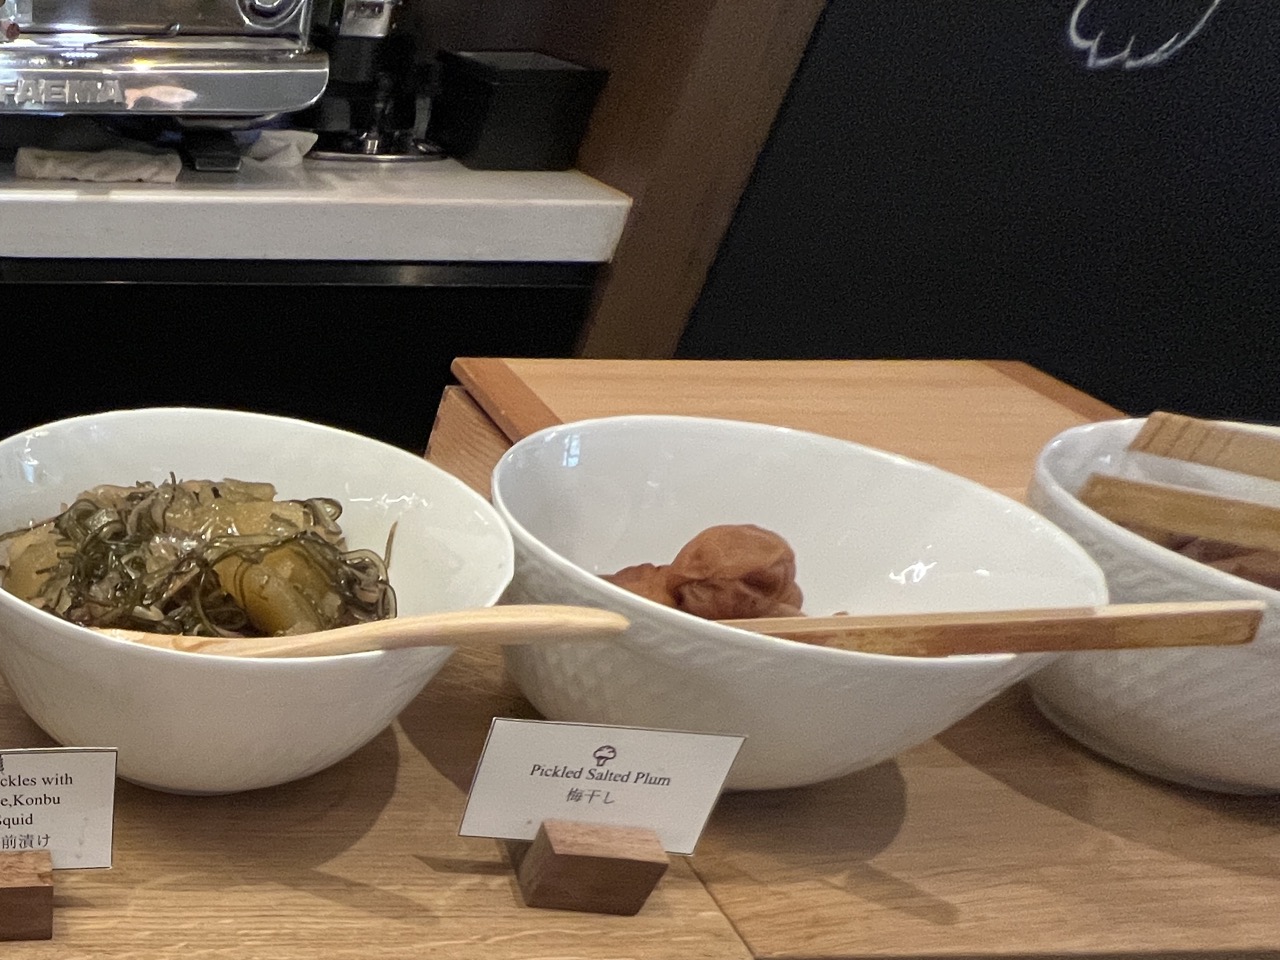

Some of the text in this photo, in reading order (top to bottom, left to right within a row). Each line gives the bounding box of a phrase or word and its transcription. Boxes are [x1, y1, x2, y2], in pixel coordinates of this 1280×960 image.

[42, 773, 73, 786] with
[530, 764, 671, 786] Pickled Salted Plum
[566, 787, 615, 804] 梅干し
